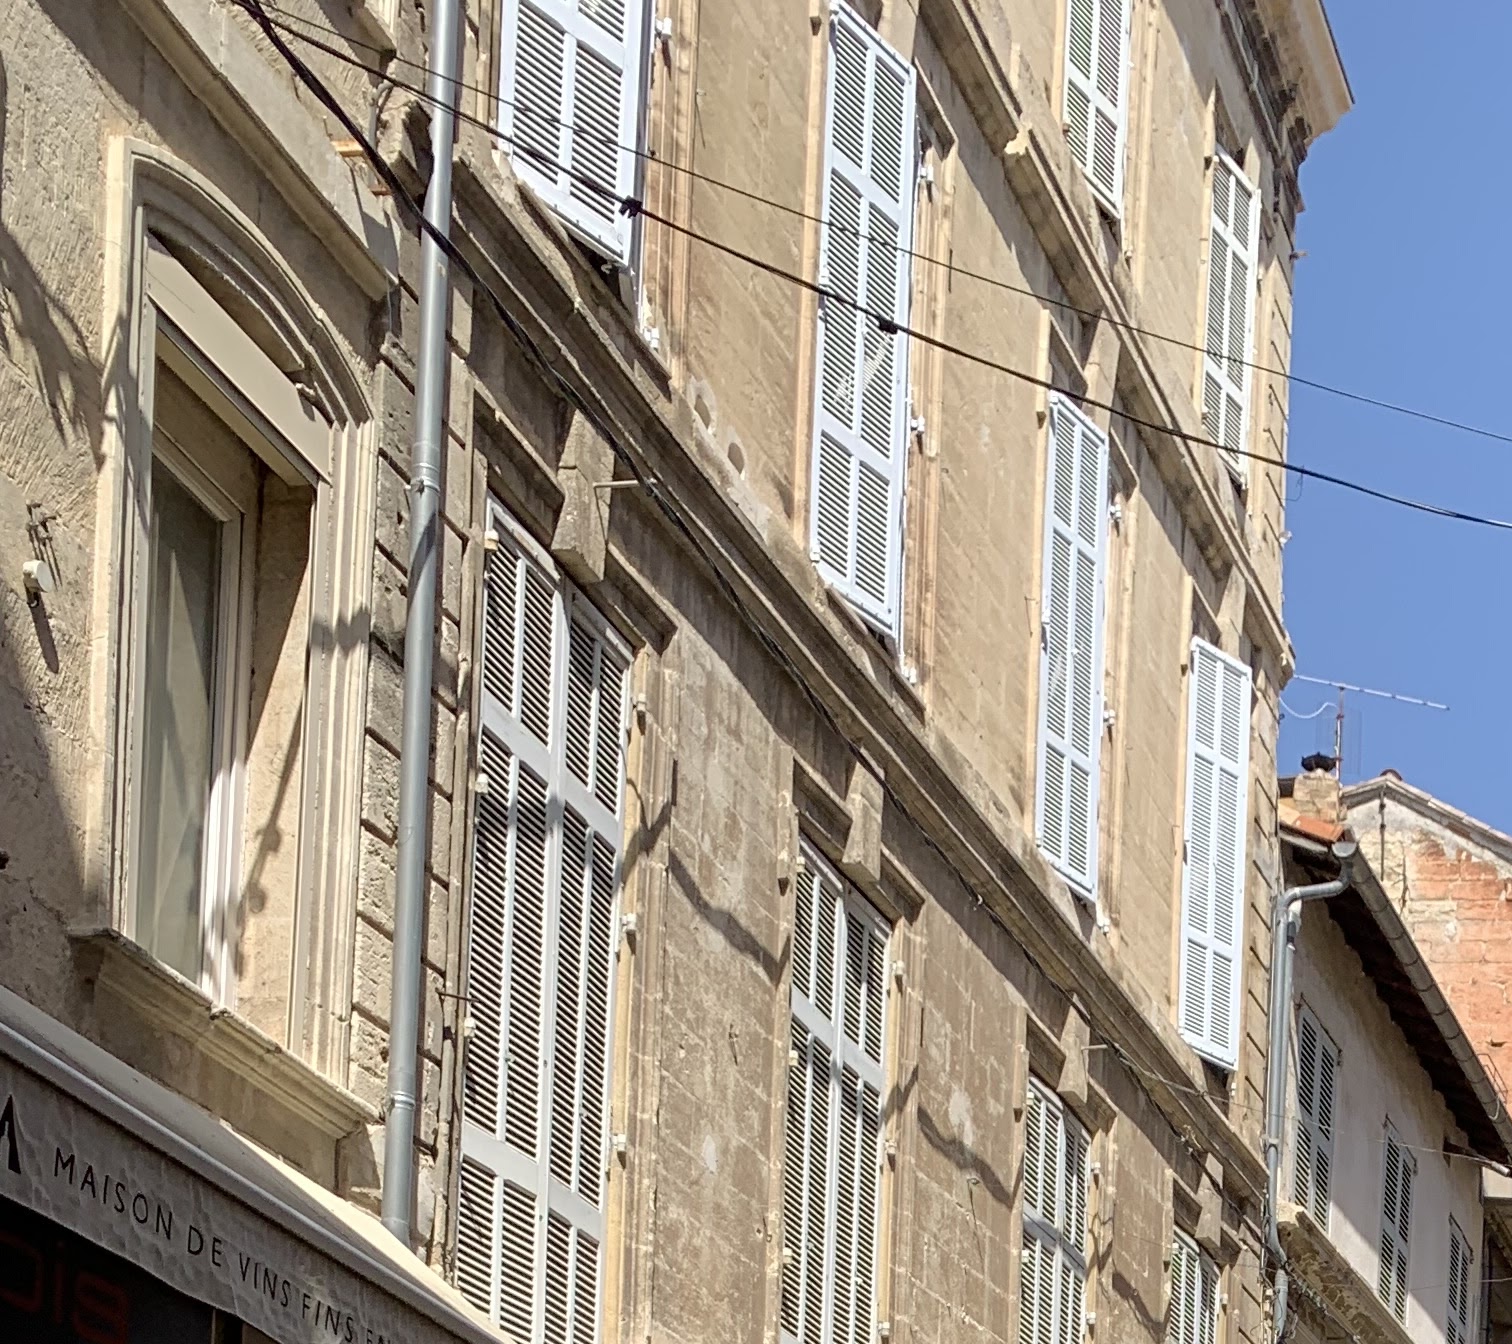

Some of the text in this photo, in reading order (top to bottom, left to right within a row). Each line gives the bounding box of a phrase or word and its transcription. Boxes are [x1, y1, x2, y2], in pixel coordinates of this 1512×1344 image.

[54, 1146, 172, 1241] MAISON
[187, 1224, 222, 1267] DE
[238, 1252, 292, 1309] VINS
[302, 1298, 354, 1344] FINS
